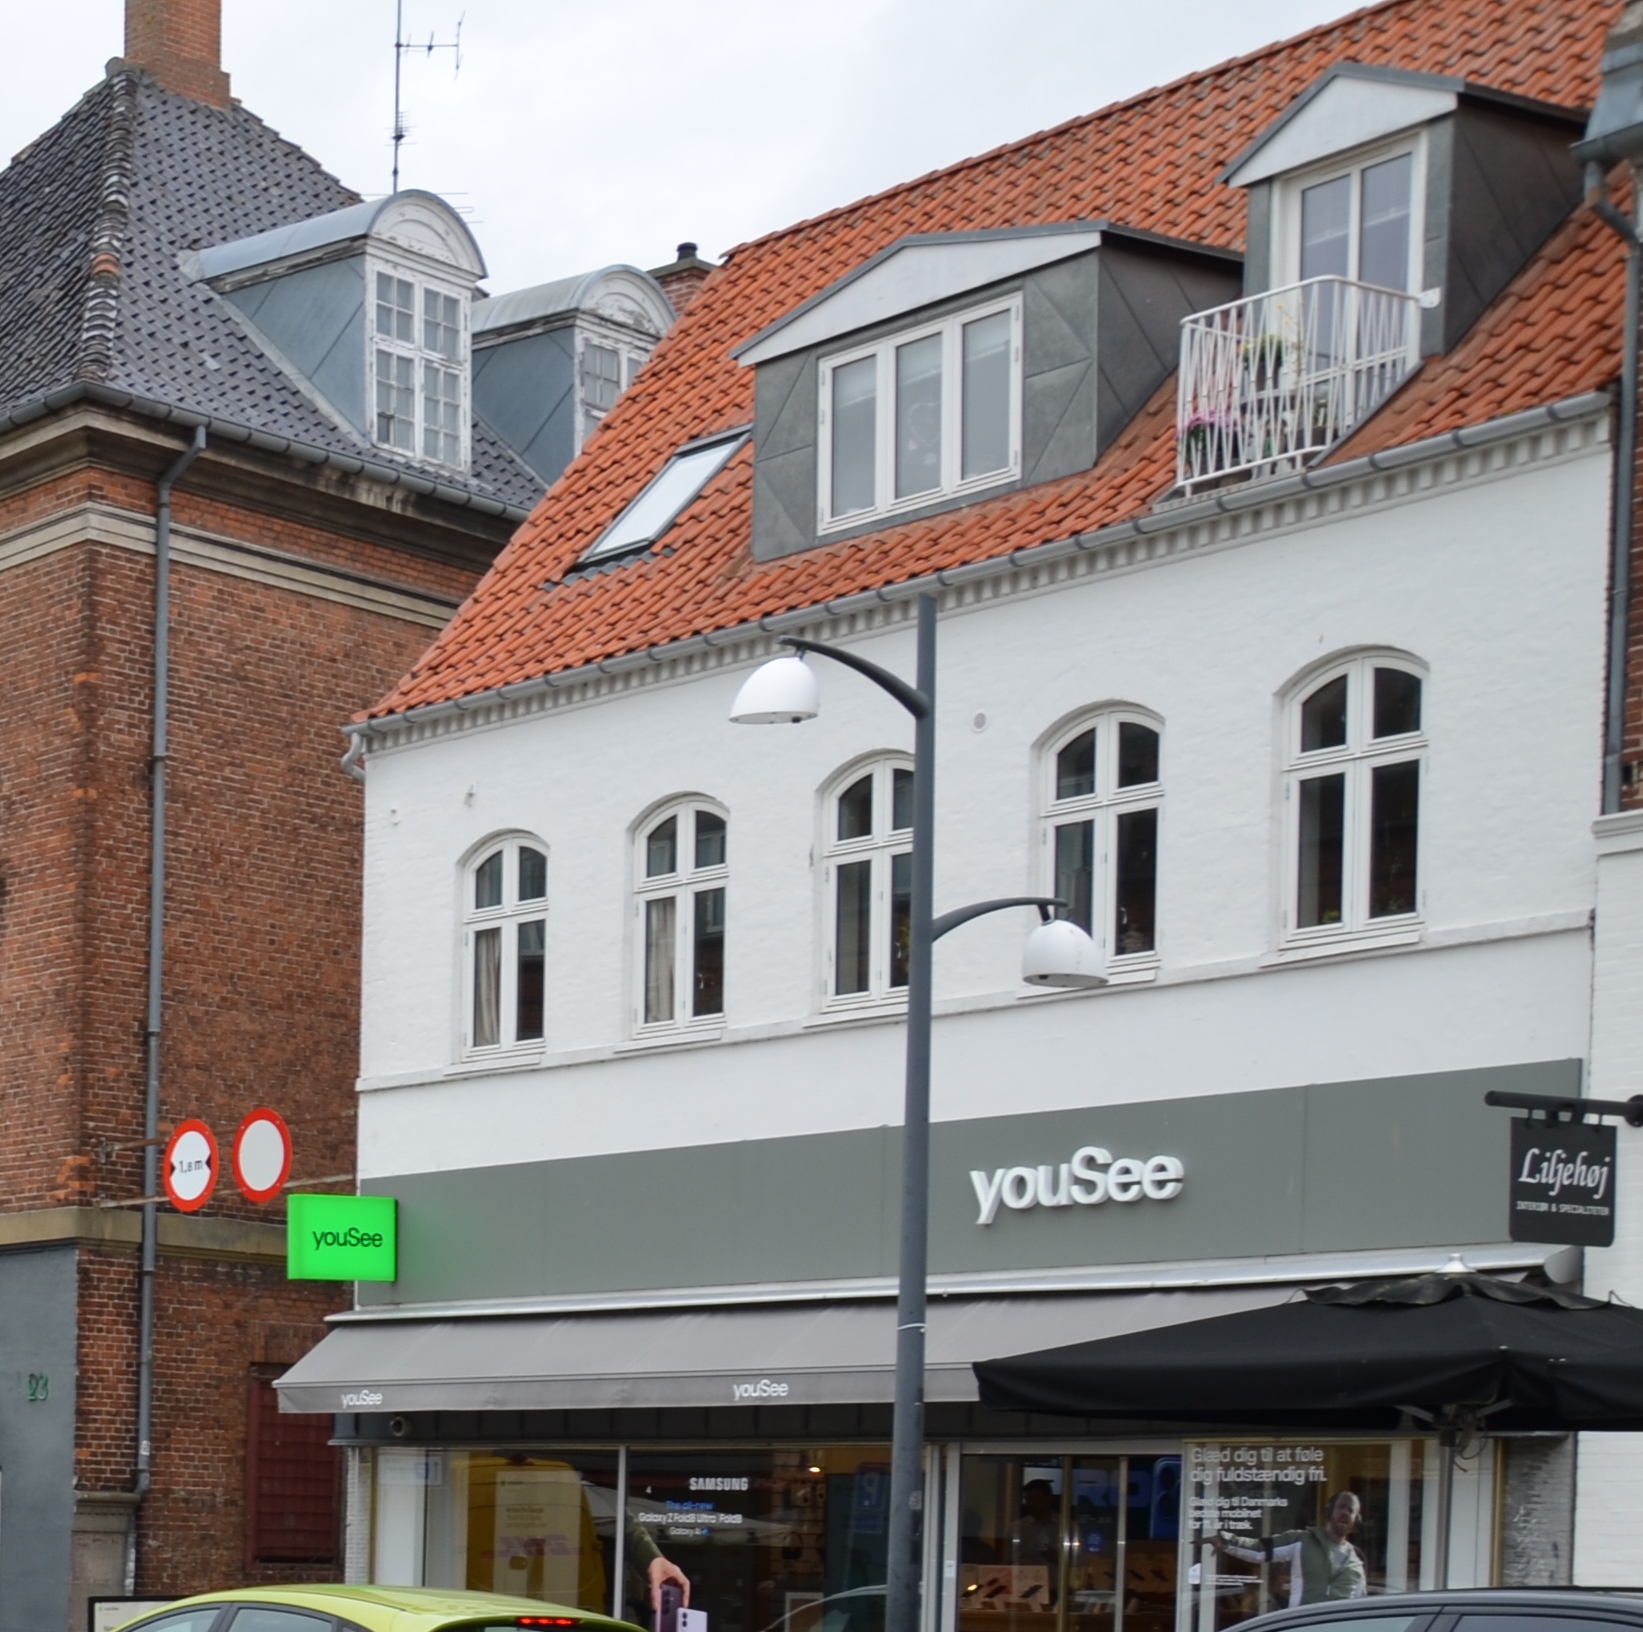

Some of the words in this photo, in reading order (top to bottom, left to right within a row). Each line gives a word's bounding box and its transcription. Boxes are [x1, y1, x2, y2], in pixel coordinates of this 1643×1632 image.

[1518, 1148, 1611, 1199] Liljehøj
[969, 1146, 1185, 1225] youSee
[313, 1227, 383, 1250] youSee
[27, 1374, 49, 1401] 23
[733, 1379, 789, 1401] youSee
[341, 1390, 382, 1408] youSee
[1192, 1448, 1230, 1462] Glæd
[1234, 1448, 1257, 1465] dig
[1261, 1448, 1273, 1462] til
[1276, 1449, 1292, 1462] at
[1295, 1447, 1323, 1462] føle
[689, 1477, 748, 1490] SAMSUNG
[1191, 1467, 1213, 1485] dig
[1217, 1467, 1305, 1485] fuldstændig
[1241, 1497, 1288, 1507] Danmarks
[638, 1513, 666, 1524] Galaxy
